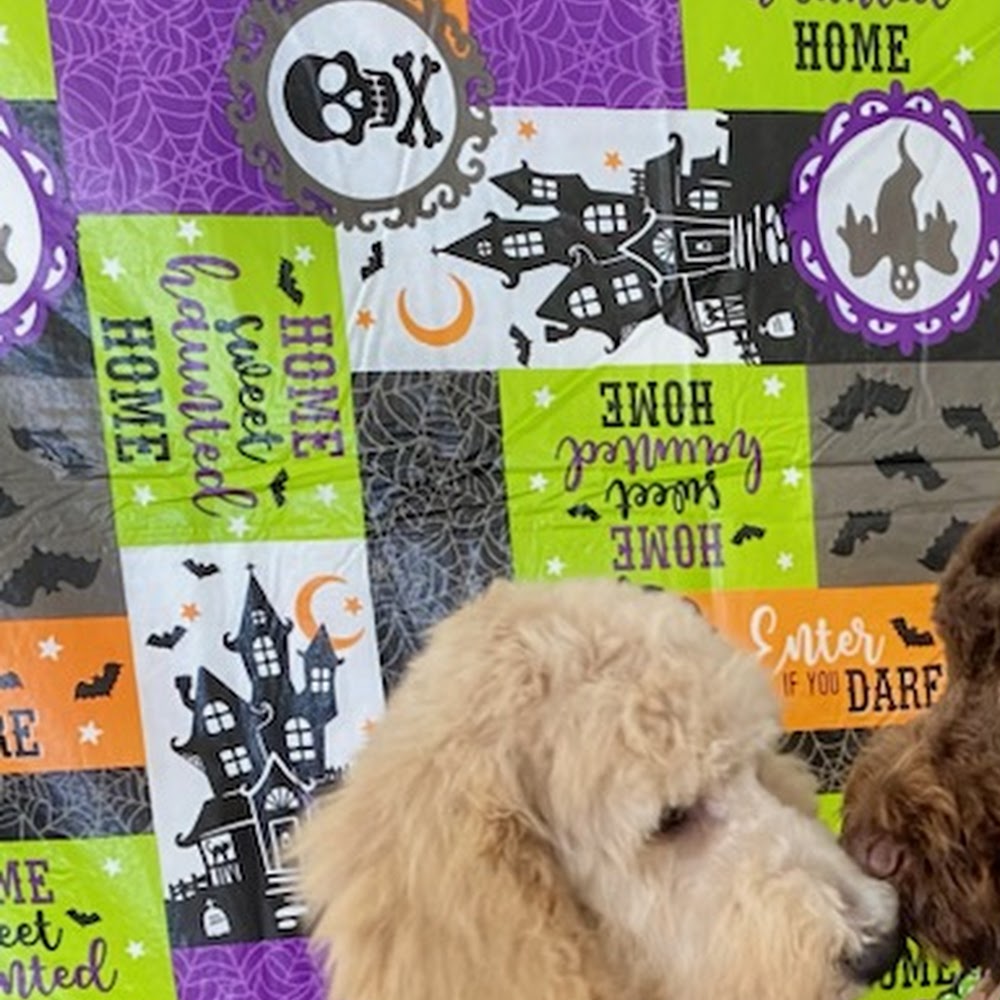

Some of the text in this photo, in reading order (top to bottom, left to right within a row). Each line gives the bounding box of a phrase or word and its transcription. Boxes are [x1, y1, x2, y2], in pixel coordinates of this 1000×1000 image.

[793, 20, 911, 73] HOME
[100, 315, 171, 464] HOME
[159, 254, 258, 518] haunted
[214, 314, 284, 464] sweet
[279, 313, 345, 459] HOME
[599, 380, 716, 428] HOME
[555, 428, 763, 495] haunted
[604, 469, 721, 520] sweet
[610, 523, 725, 571] HOME
[750, 604, 886, 679] Enter
[783, 670, 798, 696] IF
[806, 669, 840, 696] YOU
